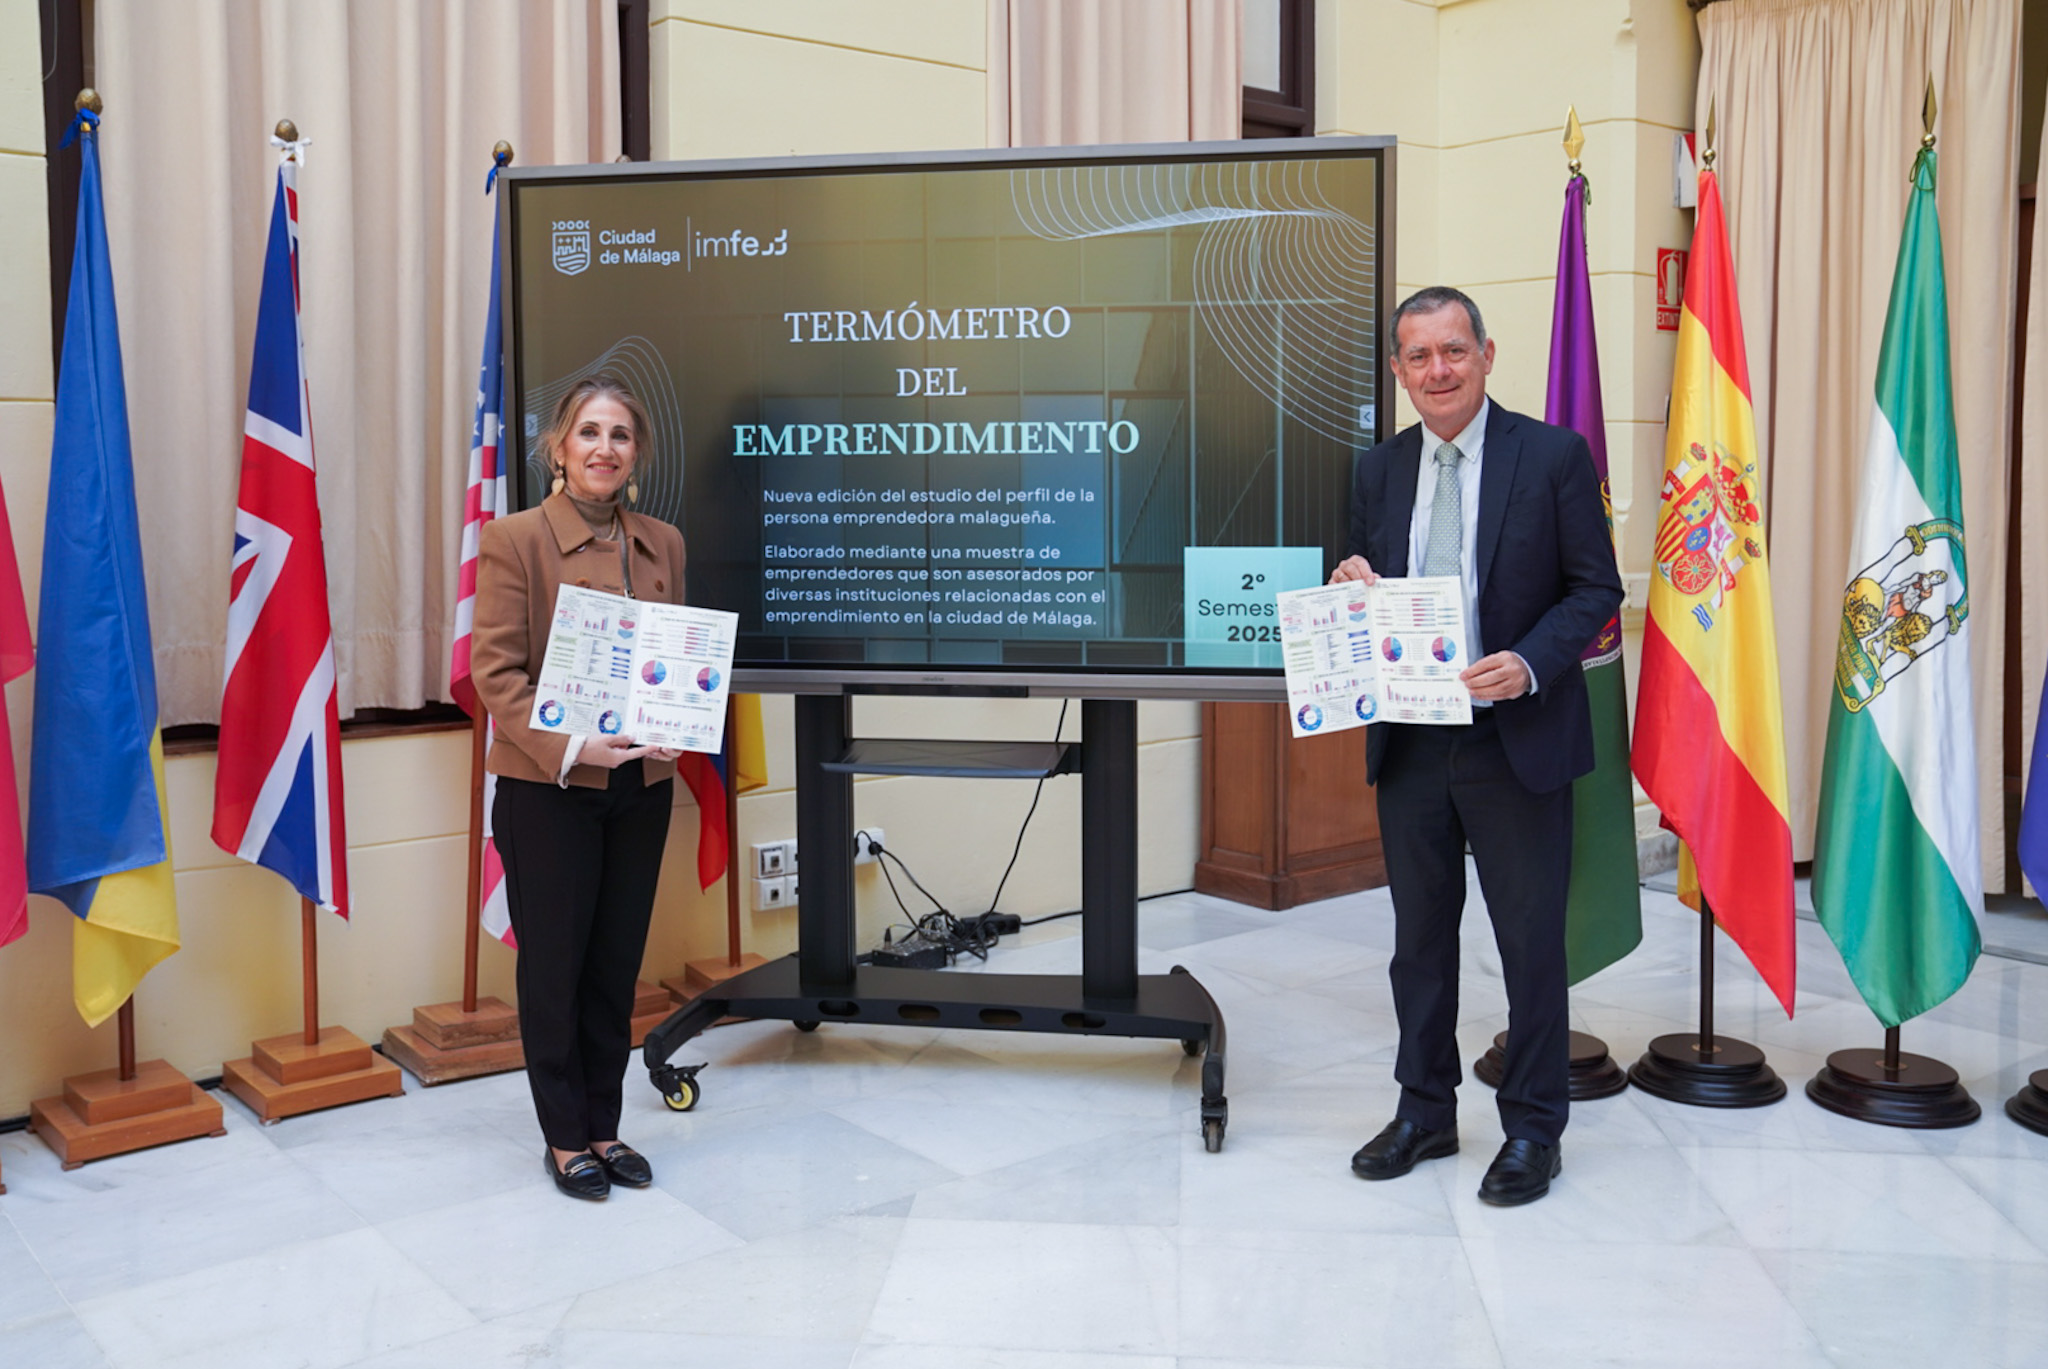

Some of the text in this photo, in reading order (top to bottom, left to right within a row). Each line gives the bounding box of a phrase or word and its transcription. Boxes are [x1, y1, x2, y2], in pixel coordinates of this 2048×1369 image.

[599, 229, 656, 246] Ciudad
[696, 229, 759, 257] imfe
[600, 247, 681, 267] de Málaga
[784, 302, 1071, 342] TERMÓMETRO
[1657, 311, 1679, 325] EXTINT
[896, 368, 967, 397] DEL
[732, 420, 1140, 456] EMPRENDIMIENTO
[764, 488, 1095, 505] Nueva edición del estudio del perfil de la
[764, 510, 1056, 527] persona emprendedora malagueña.
[765, 545, 1061, 560] Elaborado mediante una muestra de
[765, 567, 1095, 584] emprendedores que son asesorados por
[765, 588, 1105, 604] diversas instituciones relacionadas con el
[1198, 599, 1278, 617] Semes
[765, 610, 1097, 629] emprendimiento en la ciudad de Málaga.
[1228, 625, 1282, 642] 2025
